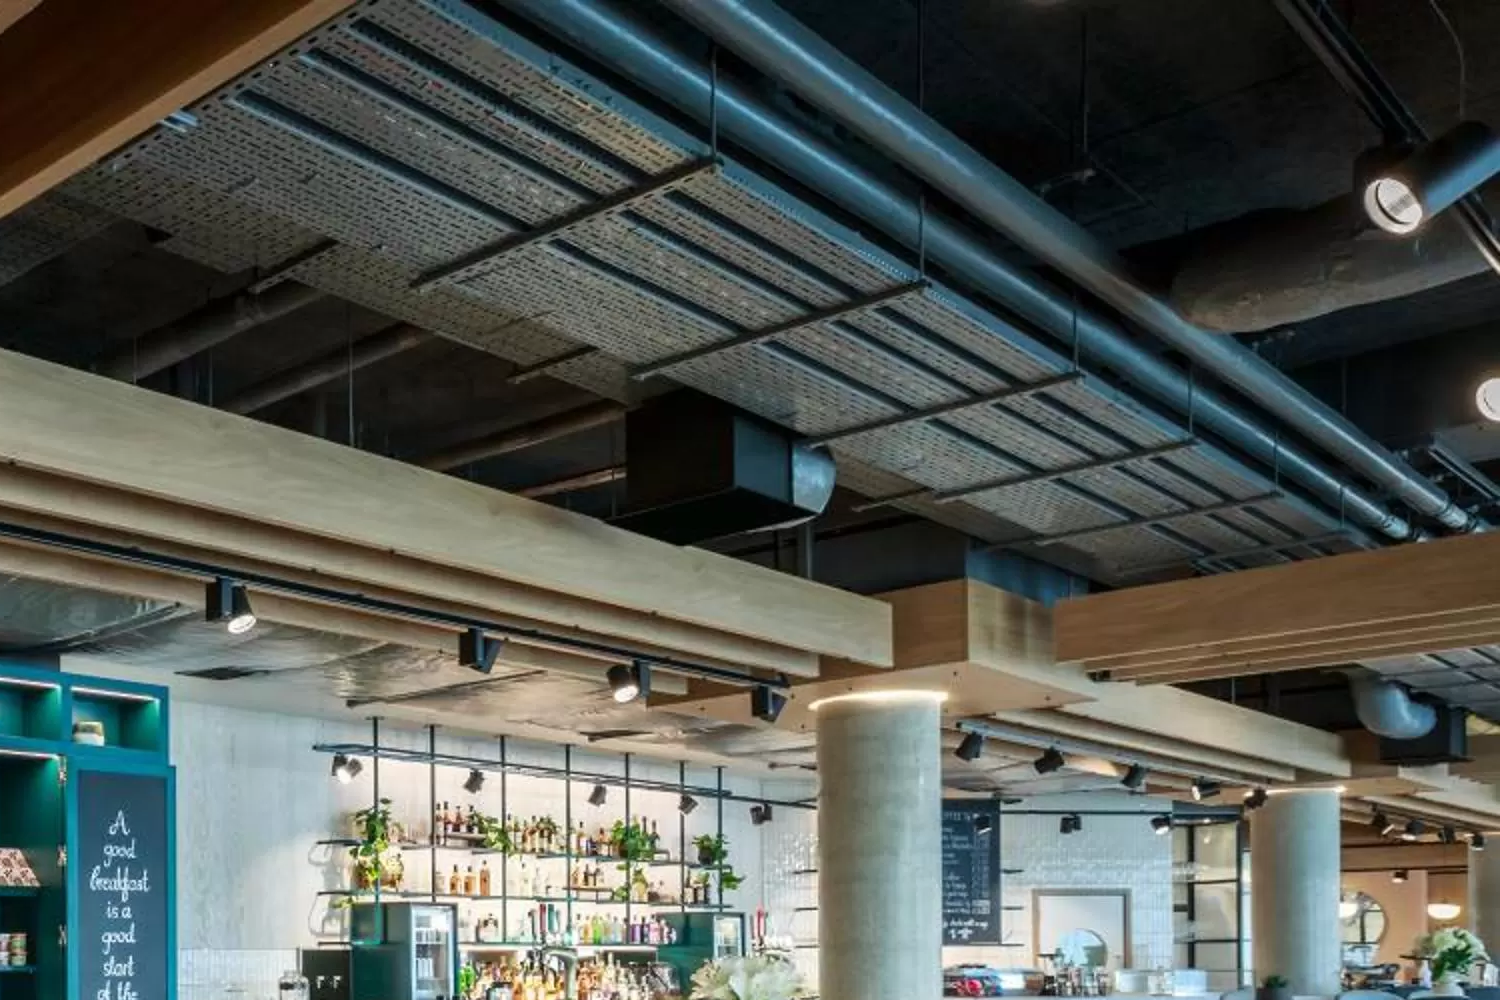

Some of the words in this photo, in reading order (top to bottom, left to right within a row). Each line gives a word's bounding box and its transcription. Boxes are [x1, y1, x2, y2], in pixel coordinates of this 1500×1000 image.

[108, 809, 131, 836] A
[103, 838, 137, 868] good
[89, 865, 151, 903] breakfast
[106, 901, 120, 919] is
[121, 905, 133, 919] a
[101, 922, 137, 956] good
[103, 955, 136, 977] start
